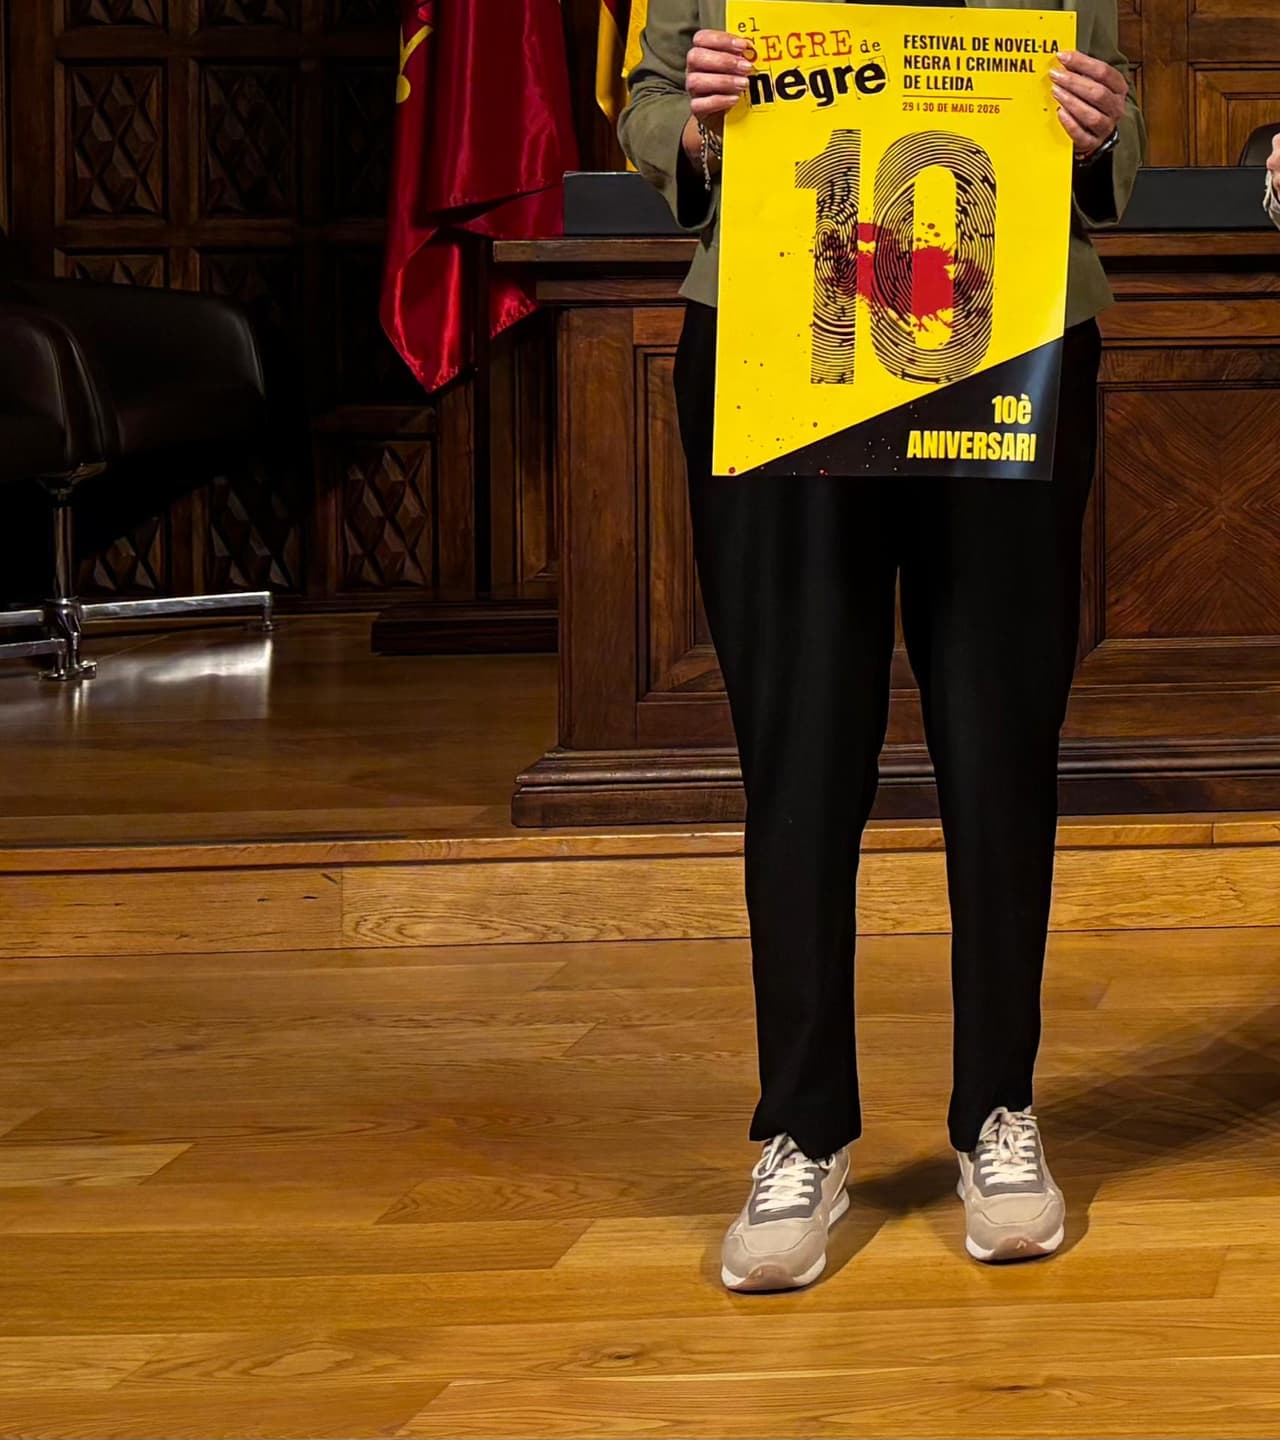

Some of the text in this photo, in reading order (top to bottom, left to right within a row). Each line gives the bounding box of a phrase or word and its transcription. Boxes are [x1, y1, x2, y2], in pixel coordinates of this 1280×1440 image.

[738, 17, 759, 32] el
[860, 40, 881, 54] de
[904, 34, 968, 51] FESTIVAL
[972, 37, 990, 51] DE
[904, 56, 1035, 72] NEGRA I CRIMINAL
[749, 62, 886, 107] negre
[903, 75, 974, 91] DE LLEIDA
[902, 103, 914, 112] 29
[922, 103, 934, 112] 30
[938, 103, 949, 112] DE
[951, 103, 974, 113] MAIG
[977, 104, 1000, 114] 2026
[795, 129, 997, 384] 10
[992, 393, 1032, 424] 10è
[907, 430, 1037, 462] ANIVERSARI
